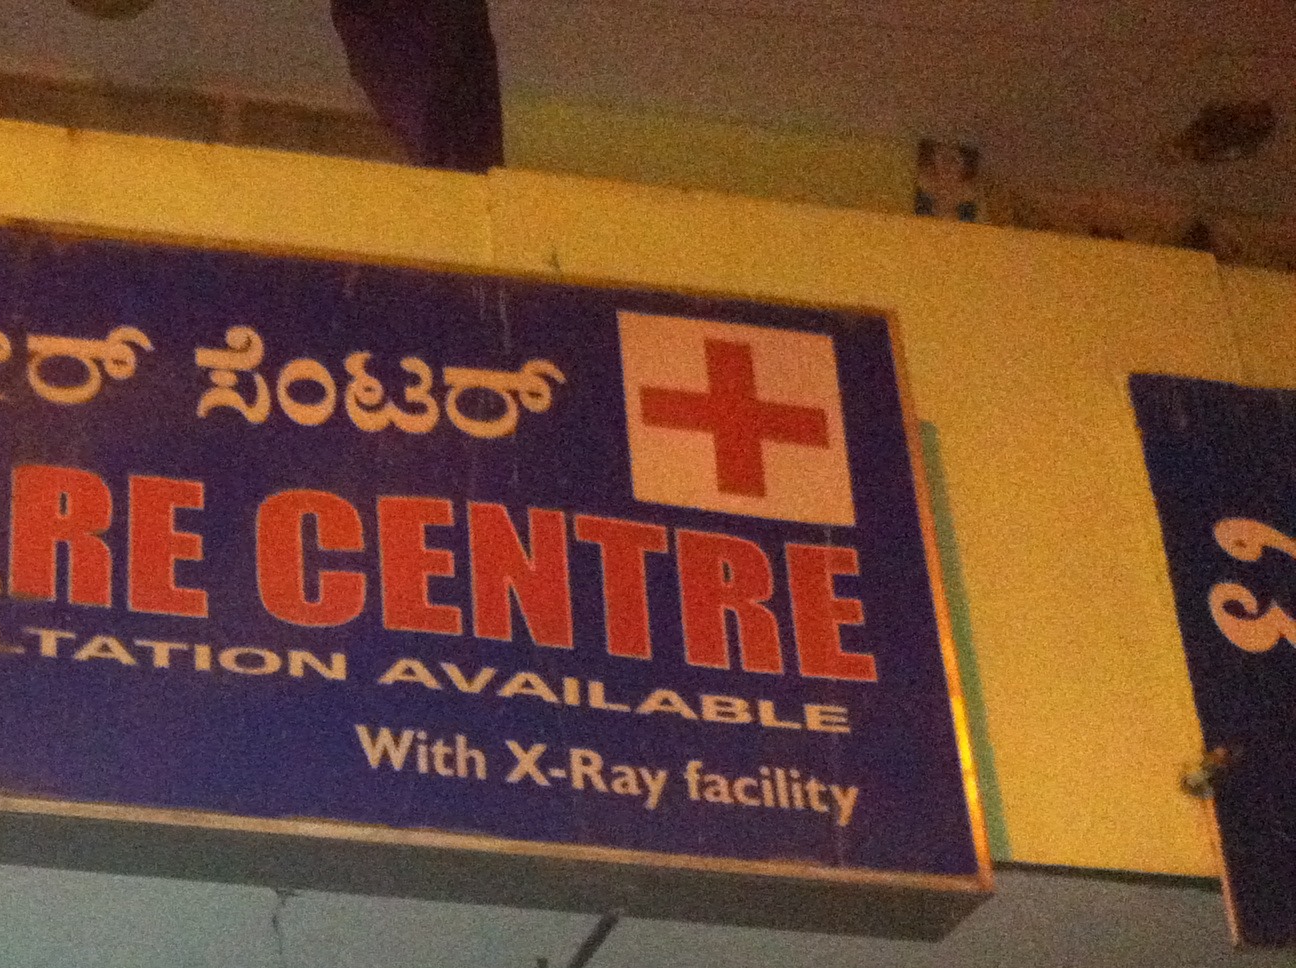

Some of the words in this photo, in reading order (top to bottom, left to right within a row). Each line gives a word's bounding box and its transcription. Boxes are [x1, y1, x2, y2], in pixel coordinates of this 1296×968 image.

[255, 489, 878, 683] CENTRE
[377, 657, 853, 734] AVAILABLE
[354, 724, 488, 780] With
[505, 738, 670, 810] X-Ray
[684, 759, 860, 826] facility
